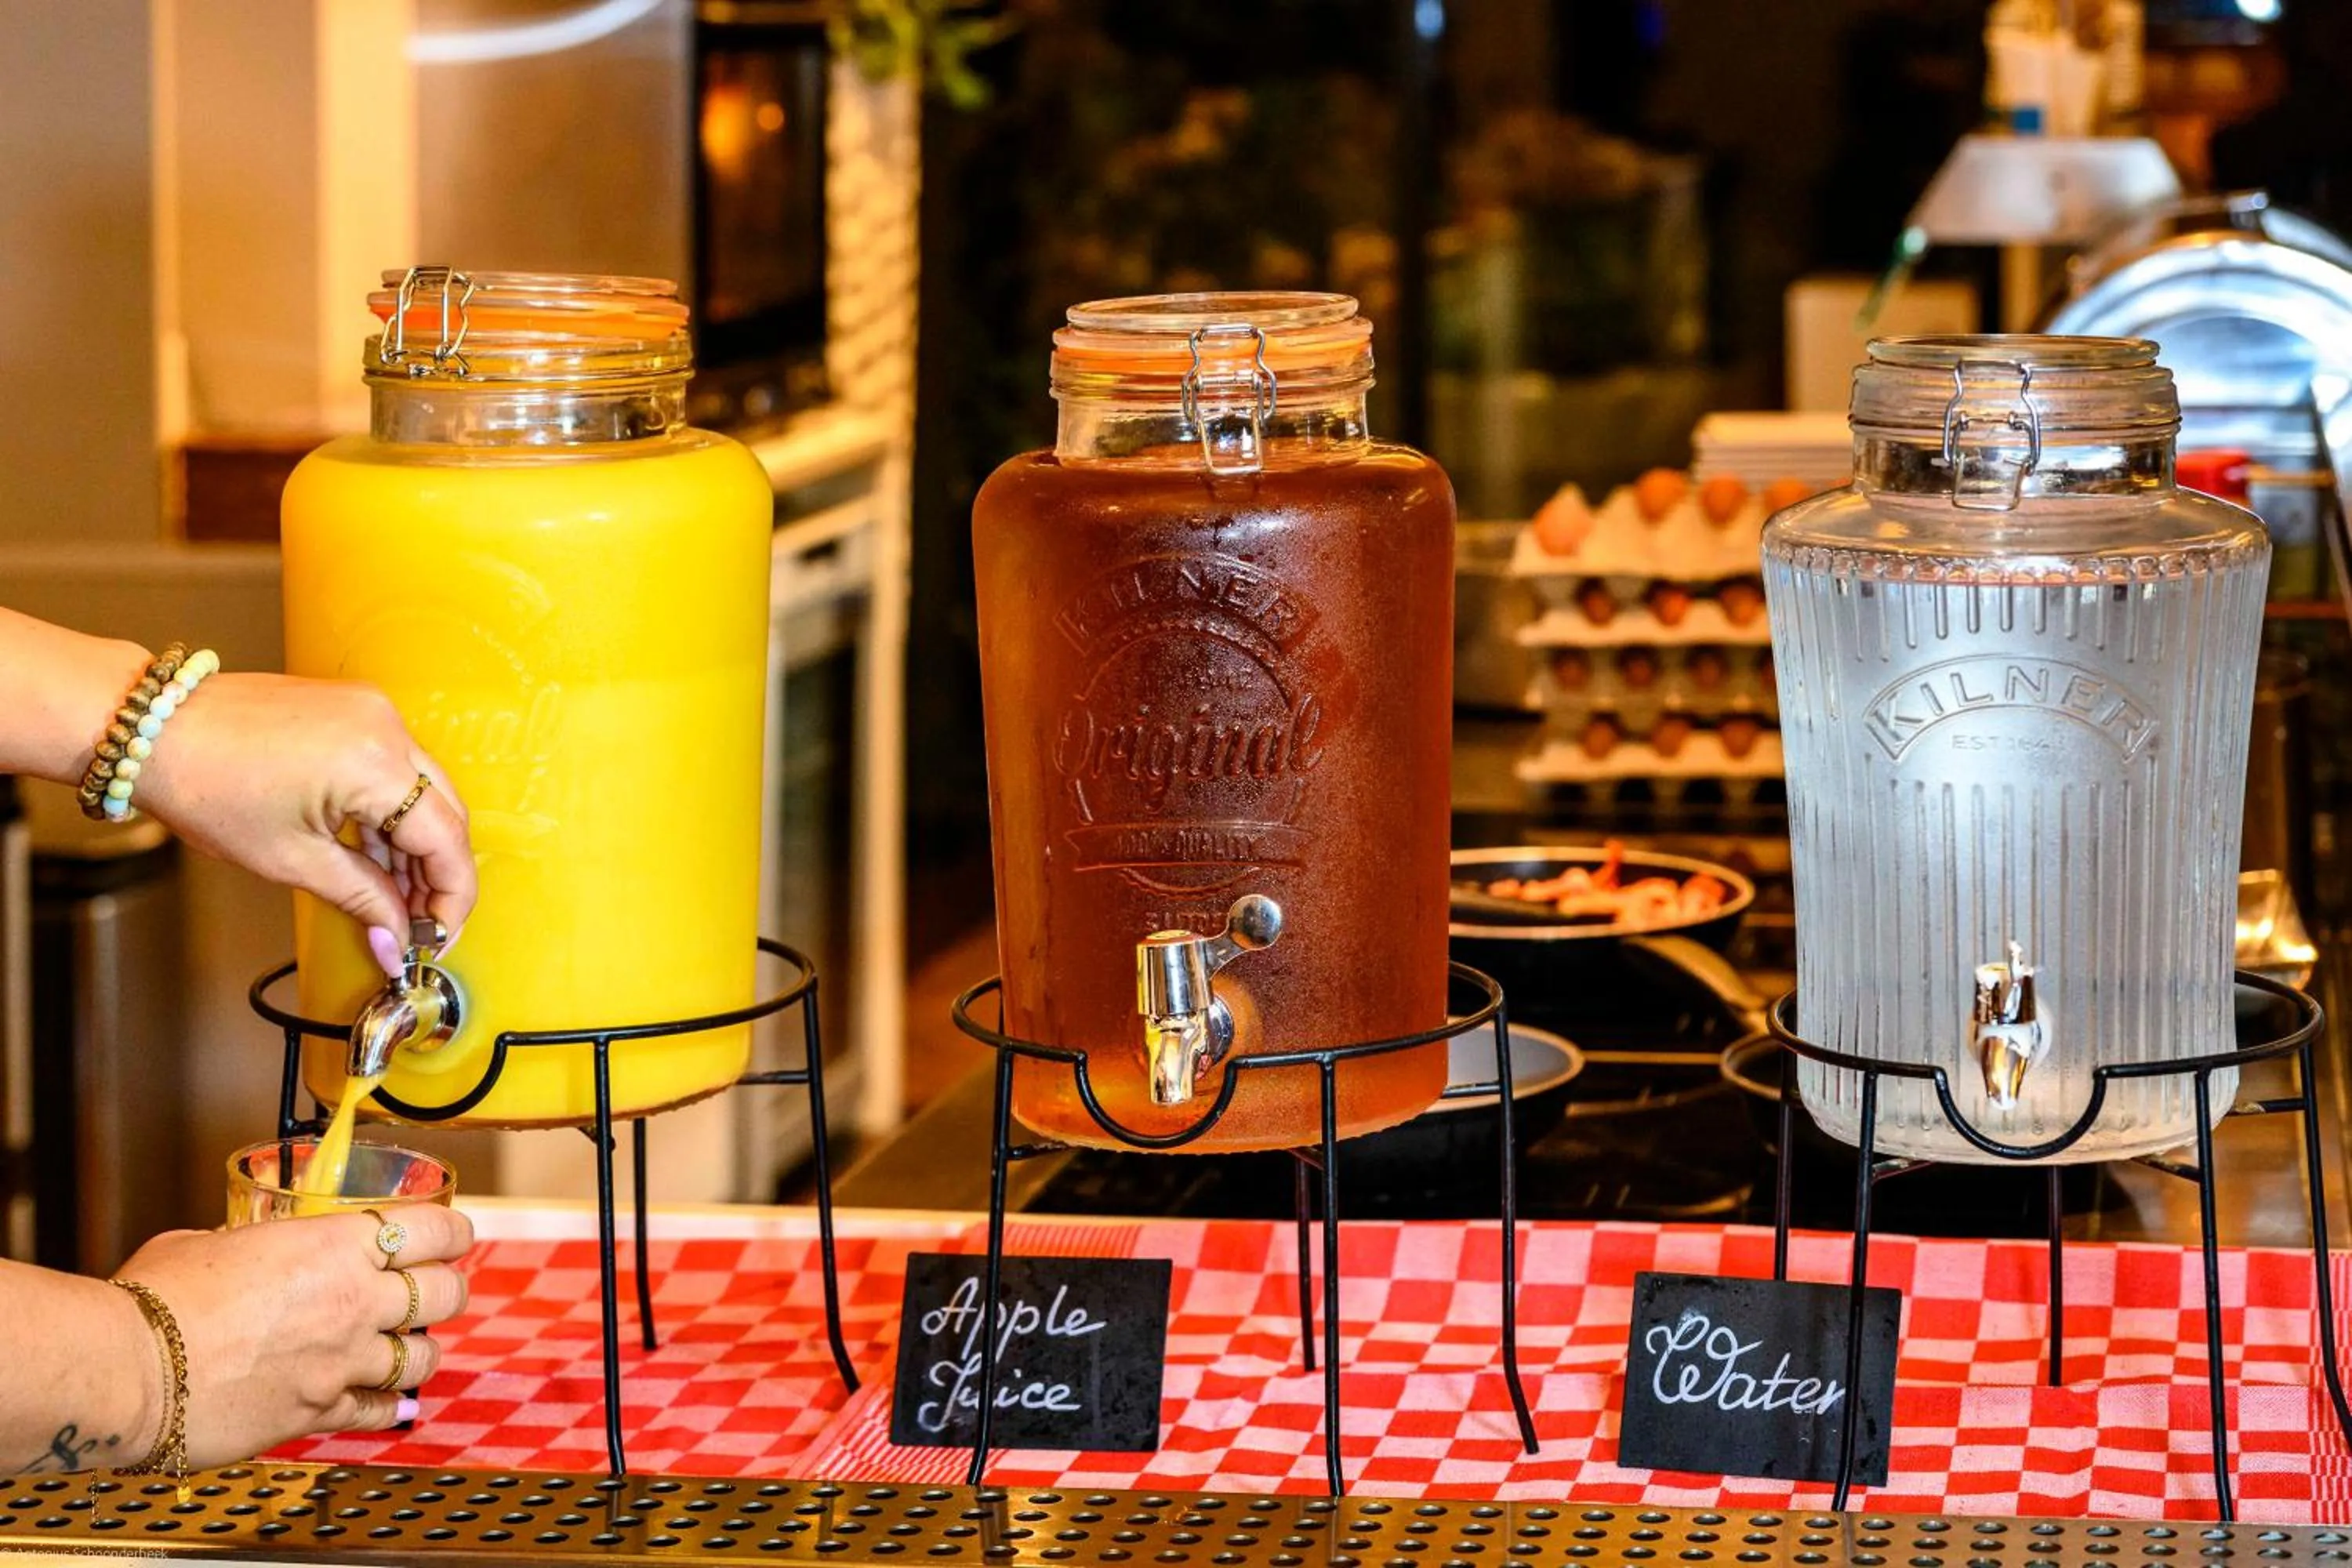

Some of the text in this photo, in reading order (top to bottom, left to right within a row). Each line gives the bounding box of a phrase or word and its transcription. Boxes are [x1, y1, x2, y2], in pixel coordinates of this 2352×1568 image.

[1052, 692, 1324, 814] Original
[1867, 665, 2158, 762] KILNER
[1951, 734, 2001, 751] EST
[920, 1276, 1107, 1363] Apple
[1646, 1315, 1846, 1415] Water
